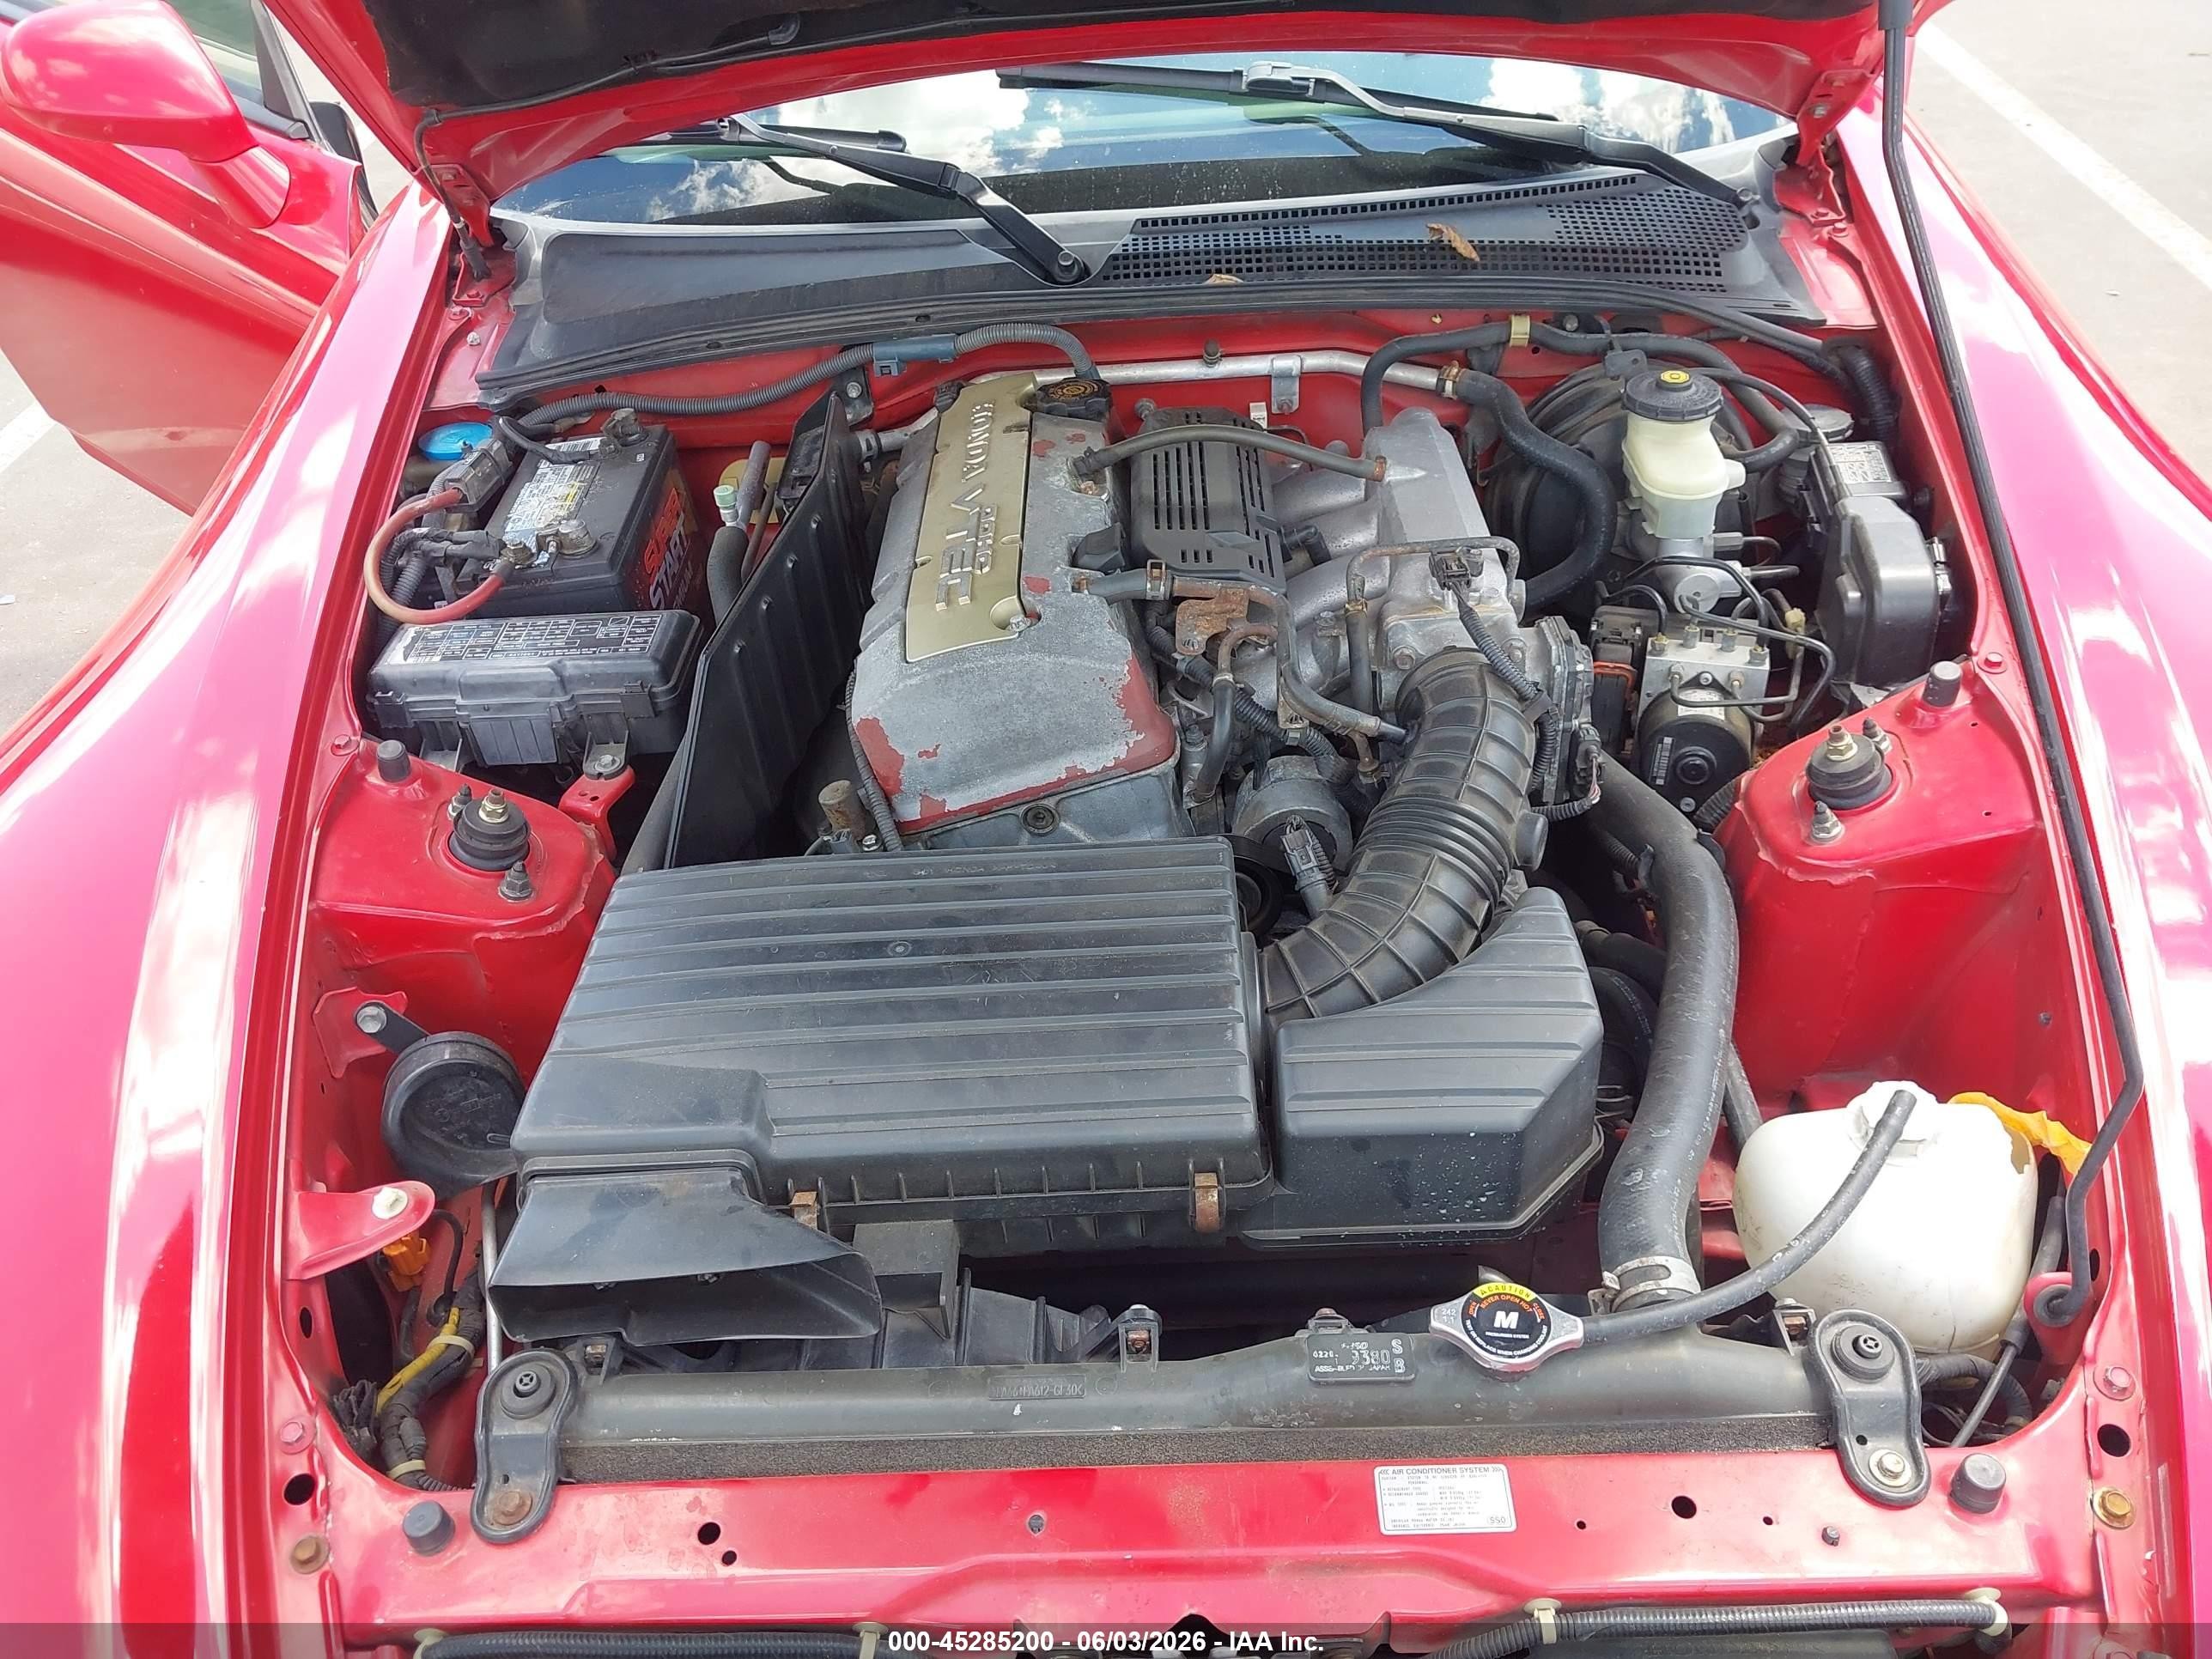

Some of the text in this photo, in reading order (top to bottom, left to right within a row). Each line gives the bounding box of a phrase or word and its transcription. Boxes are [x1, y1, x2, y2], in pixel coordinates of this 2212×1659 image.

[936, 402, 994, 611] HONDA VTEC
[649, 510, 688, 610] START
[1487, 1285, 1531, 1298] CAUTION
[1468, 1301, 1477, 1316] OPEN
[1480, 1294, 1533, 1313] NEVER OPEN HOT
[1533, 1303, 1545, 1320] CLOSE
[1443, 1316, 1455, 1324] 1.1
[1493, 1310, 1520, 1329] M
[1391, 1339, 1403, 1354] S
[1475, 1336, 1497, 1353] REPLACE
[1535, 1324, 1547, 1345] COOLANT
[1393, 1358, 1406, 1373] B
